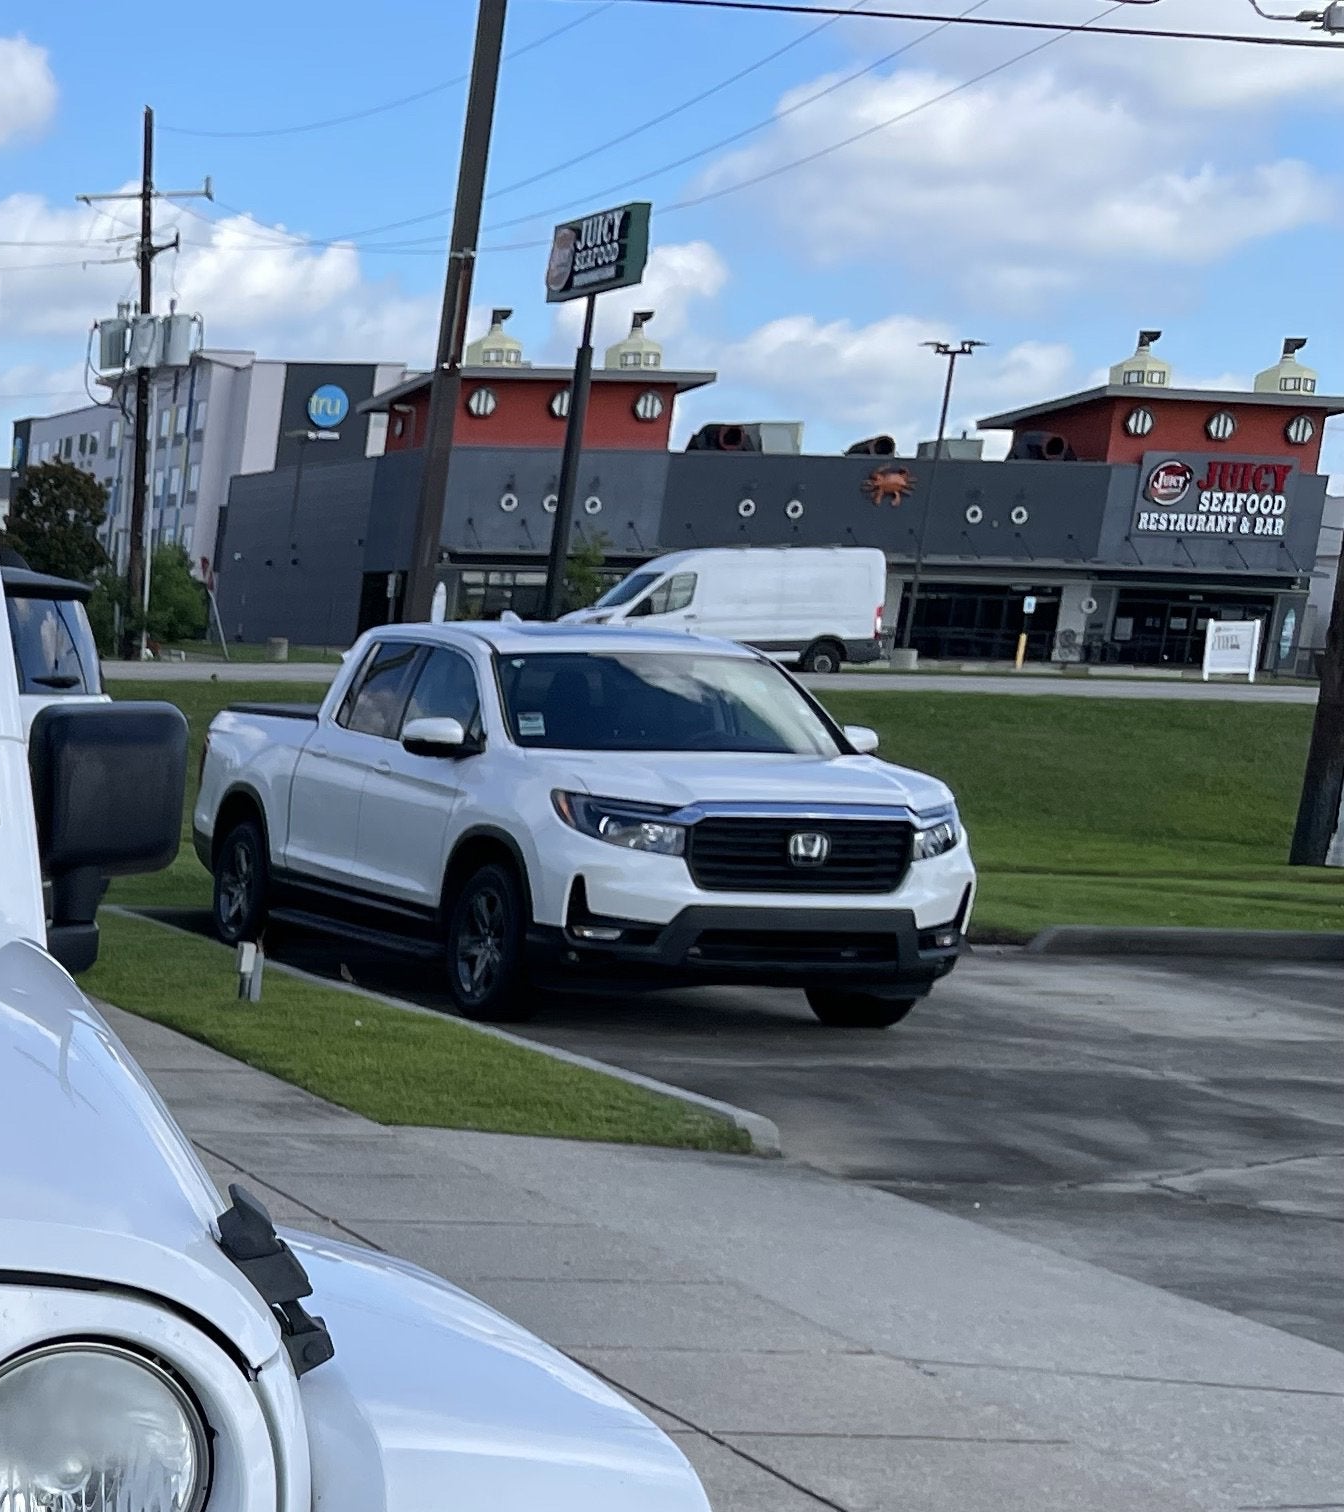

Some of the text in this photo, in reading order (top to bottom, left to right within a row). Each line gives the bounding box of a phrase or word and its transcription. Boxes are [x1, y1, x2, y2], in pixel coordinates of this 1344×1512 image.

[574, 208, 626, 250] JUICY
[309, 394, 341, 416] tru
[1196, 461, 1293, 493] JUICY
[1198, 491, 1286, 516] SEAFOOD
[1138, 512, 1285, 536] RESTAURANT & BAR
